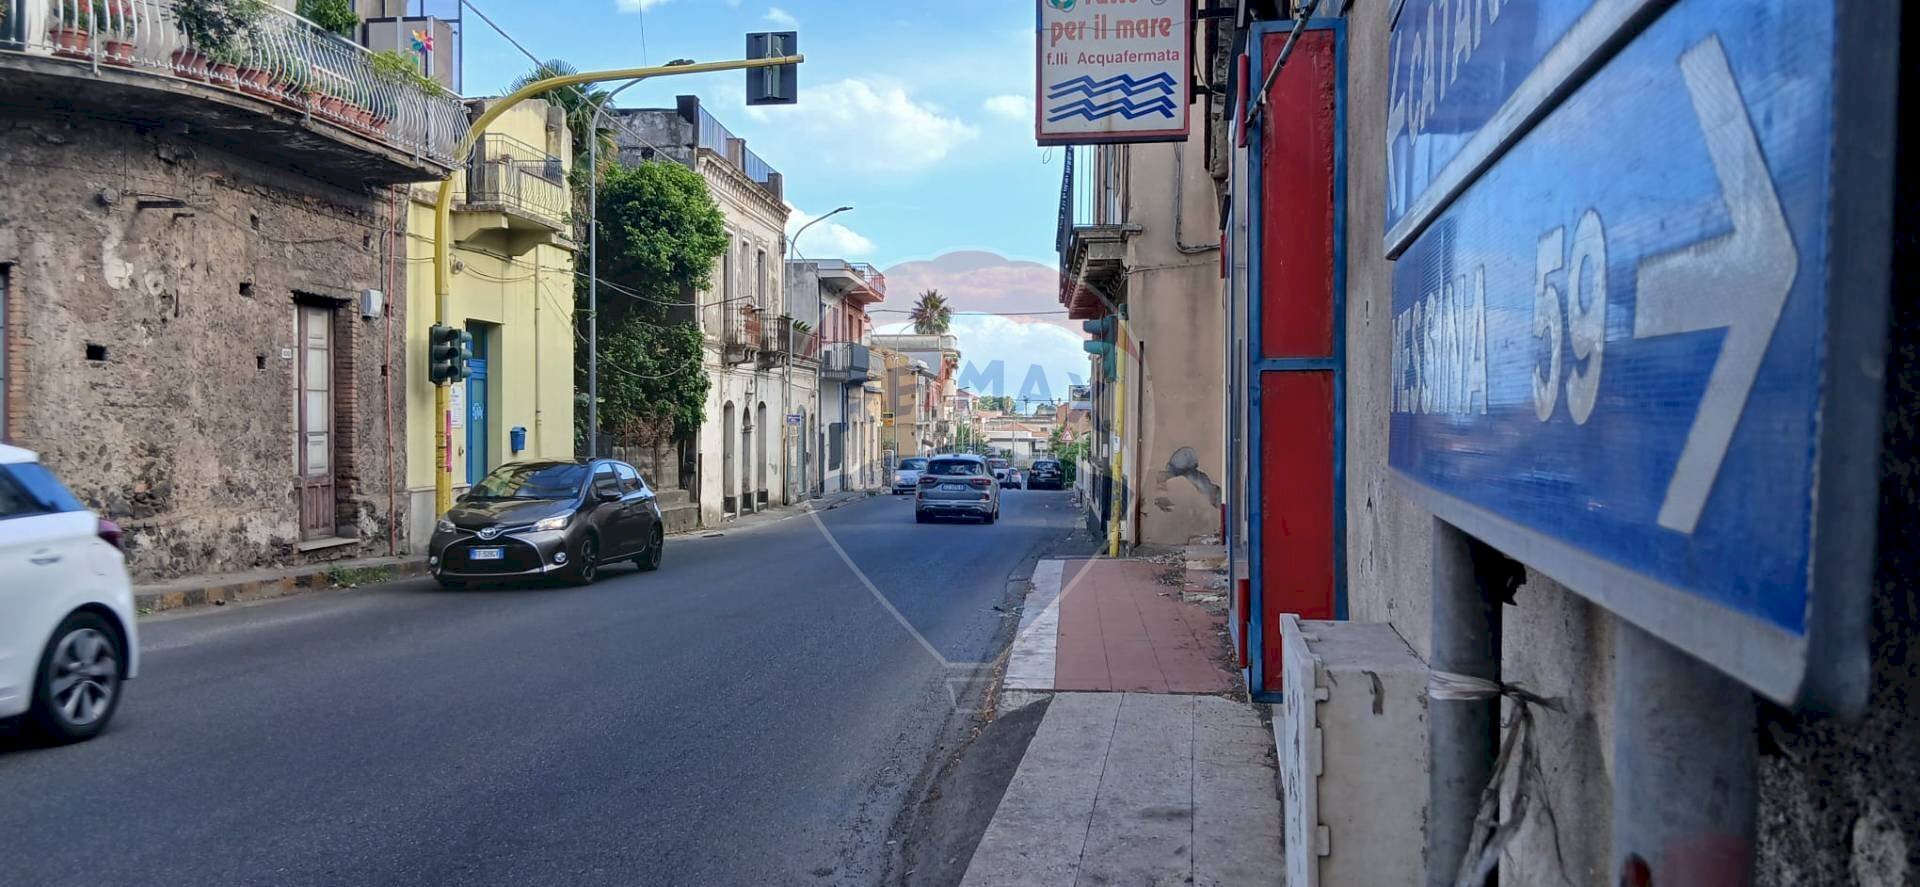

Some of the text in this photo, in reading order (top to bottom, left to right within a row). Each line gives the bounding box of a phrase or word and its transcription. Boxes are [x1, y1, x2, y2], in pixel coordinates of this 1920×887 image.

[1051, 14, 1172, 48] per il mare
[1077, 49, 1180, 67] Acquafermata
[1390, 208, 1606, 425] MESSINA 59
